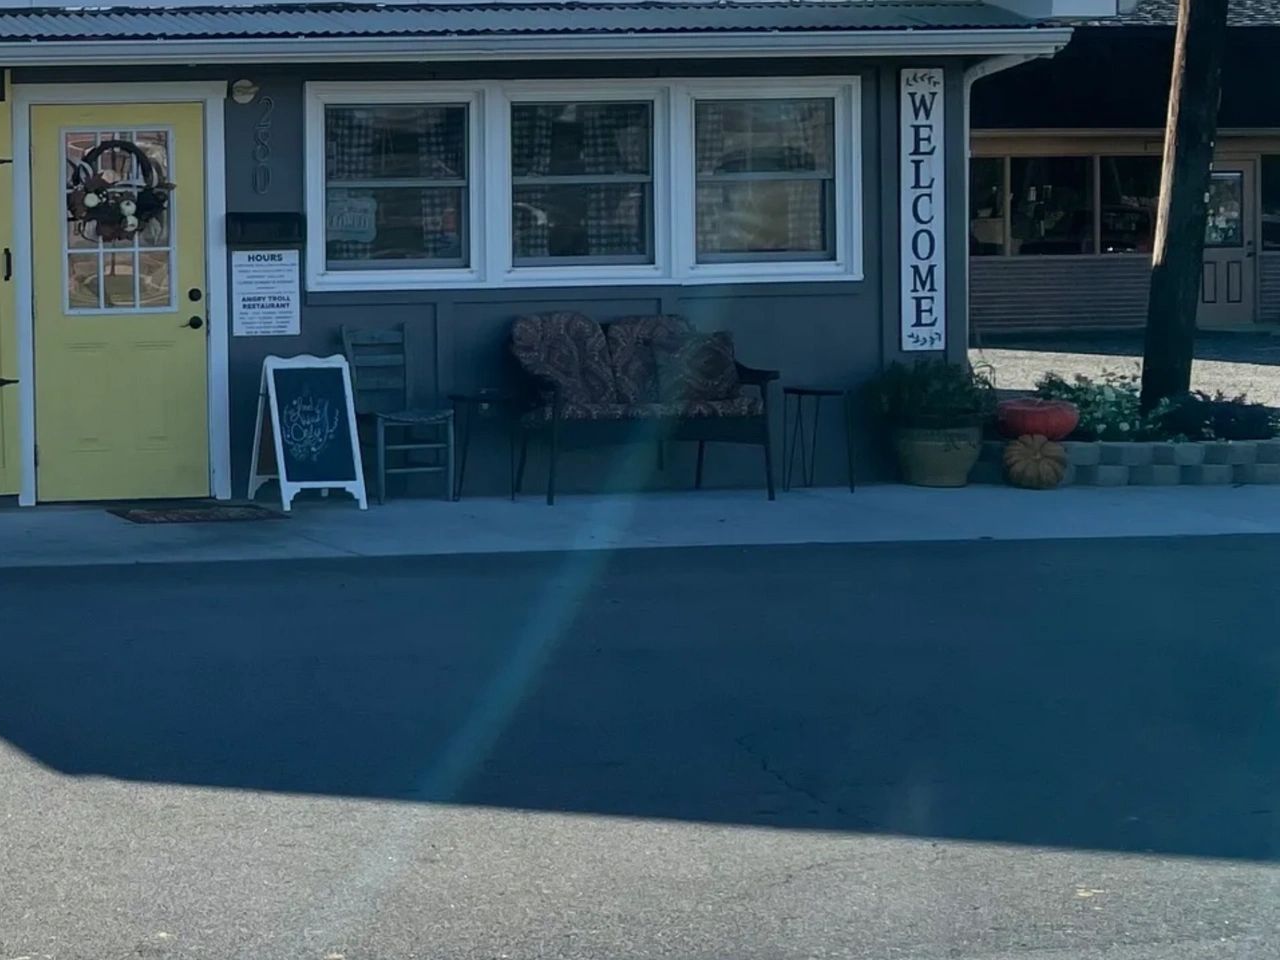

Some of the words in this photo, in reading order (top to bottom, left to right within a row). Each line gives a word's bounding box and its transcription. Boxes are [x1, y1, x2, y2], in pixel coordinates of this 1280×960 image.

[253, 96, 274, 194] 280
[247, 254, 283, 262] HOURS
[907, 92, 938, 328] WELCOME
